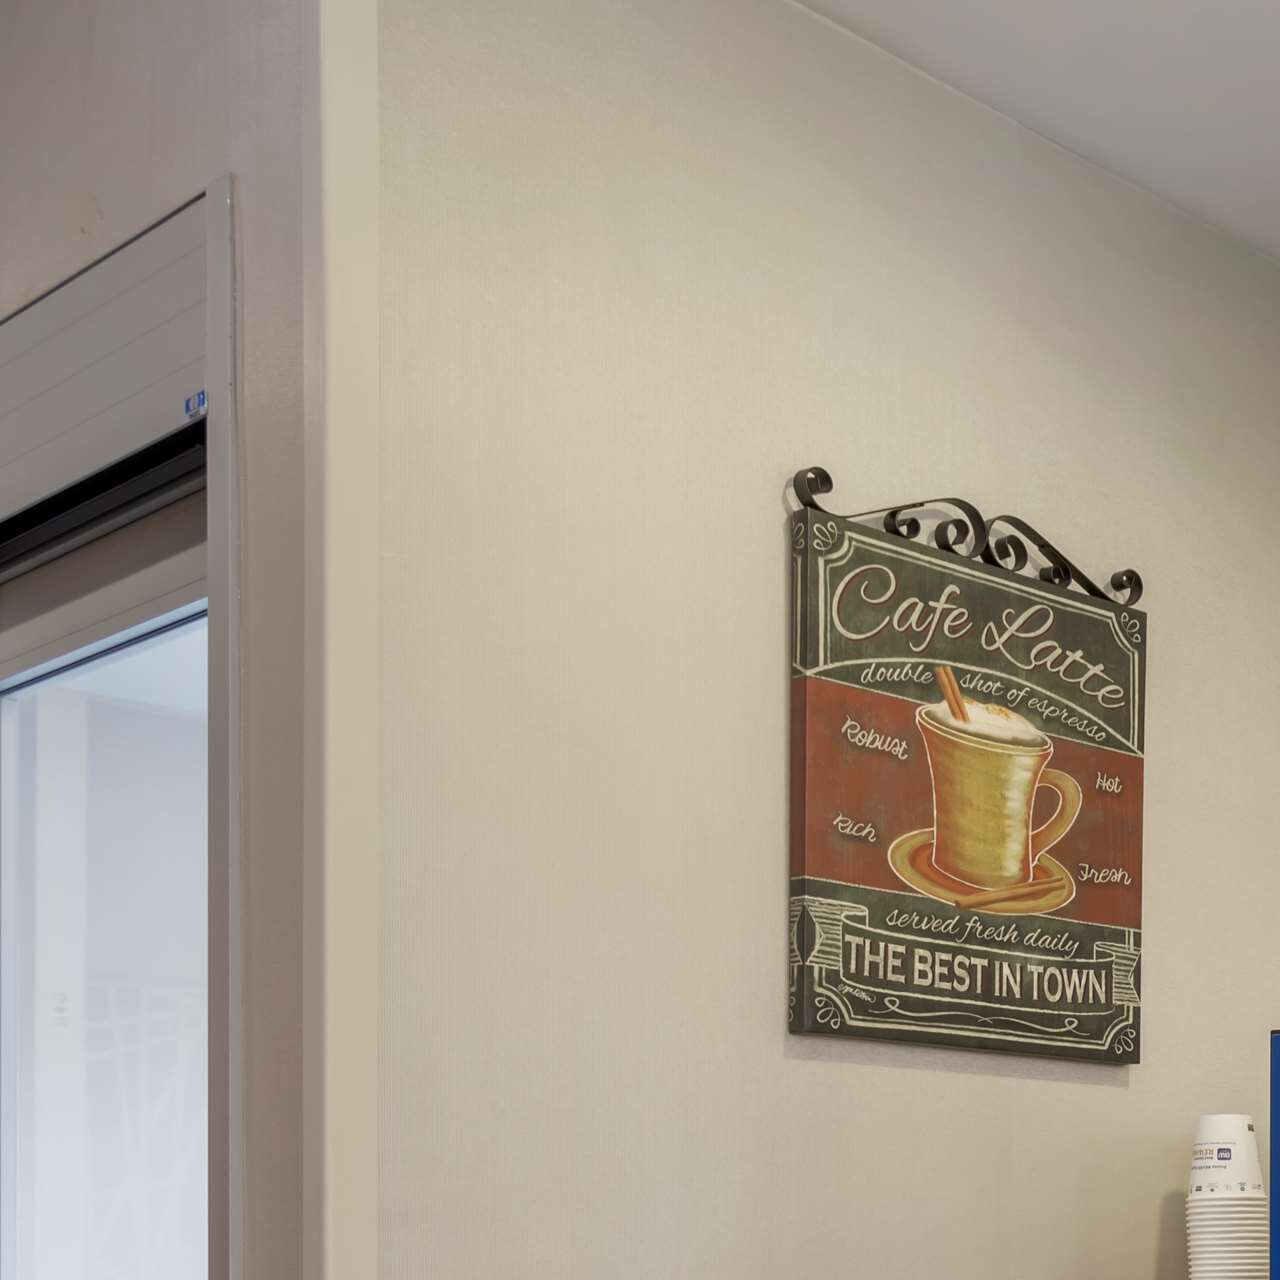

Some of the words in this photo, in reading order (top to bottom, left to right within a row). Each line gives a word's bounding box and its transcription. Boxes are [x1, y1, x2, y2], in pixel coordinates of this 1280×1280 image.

[832, 564, 973, 652] Cafe
[980, 604, 1125, 708] Latte
[861, 662, 934, 685] double
[959, 671, 1004, 696] shot
[1007, 687, 1029, 708] of
[1028, 696, 1107, 742] espresso
[841, 714, 909, 761] Robust
[1096, 771, 1121, 794] Hot
[832, 812, 877, 843] Rich
[886, 909, 961, 934] served
[956, 917, 1021, 943] fresh
[1024, 927, 1079, 959] daily
[845, 934, 906, 984] THE
[913, 949, 988, 994] BEST
[994, 961, 1021, 998] IN
[1027, 964, 1107, 1004] TOWN
